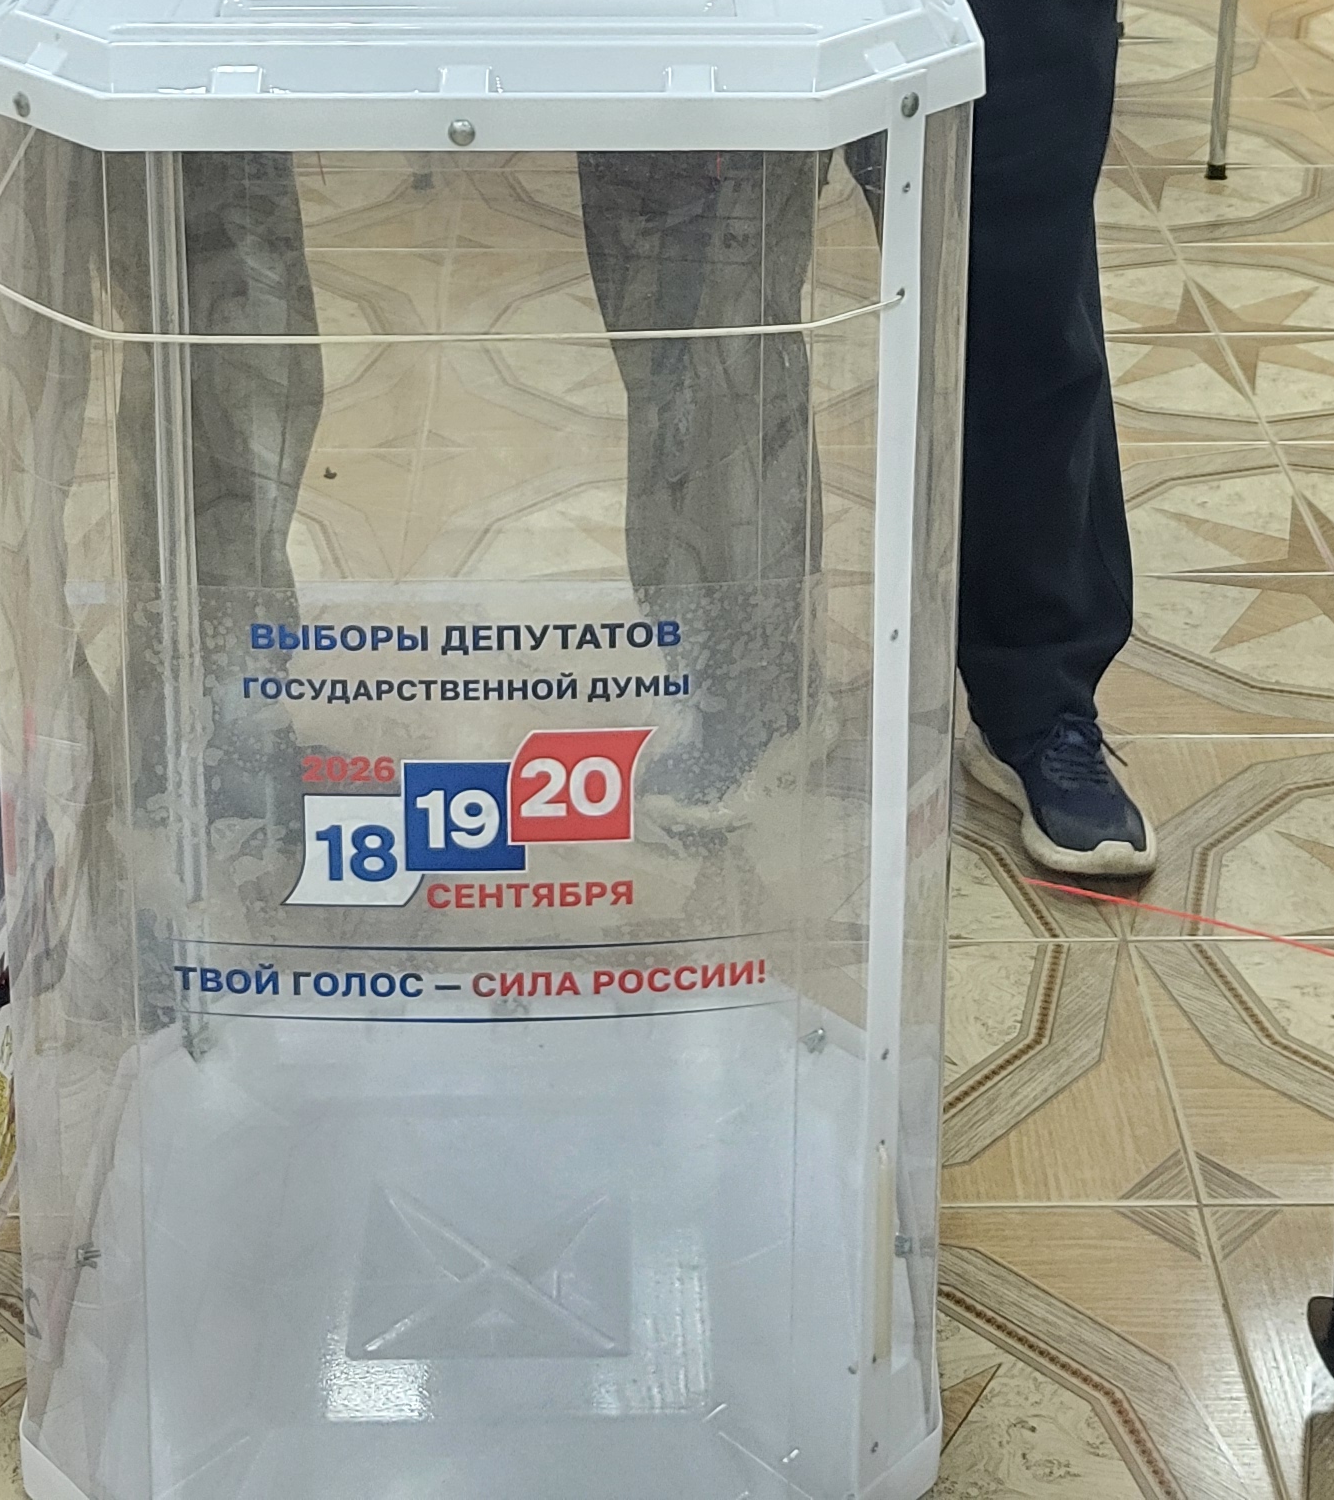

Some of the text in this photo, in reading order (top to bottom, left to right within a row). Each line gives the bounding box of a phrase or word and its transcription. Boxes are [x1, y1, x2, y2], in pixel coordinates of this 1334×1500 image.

[250, 620, 682, 655] ВЫБОРЫ ДЕПУТАТОВ
[243, 673, 690, 703] ГОСУДАРСТВЕННОЙ ДУМЫ
[301, 755, 395, 783] 2026
[315, 756, 623, 882] 18 19 20
[426, 880, 634, 908] СЕНТЯБРЯ
[174, 963, 280, 997] ТВОЙ
[293, 972, 424, 998] ГОЛОС
[472, 970, 581, 998] СИЛА
[593, 959, 767, 996] РОССИИ!
